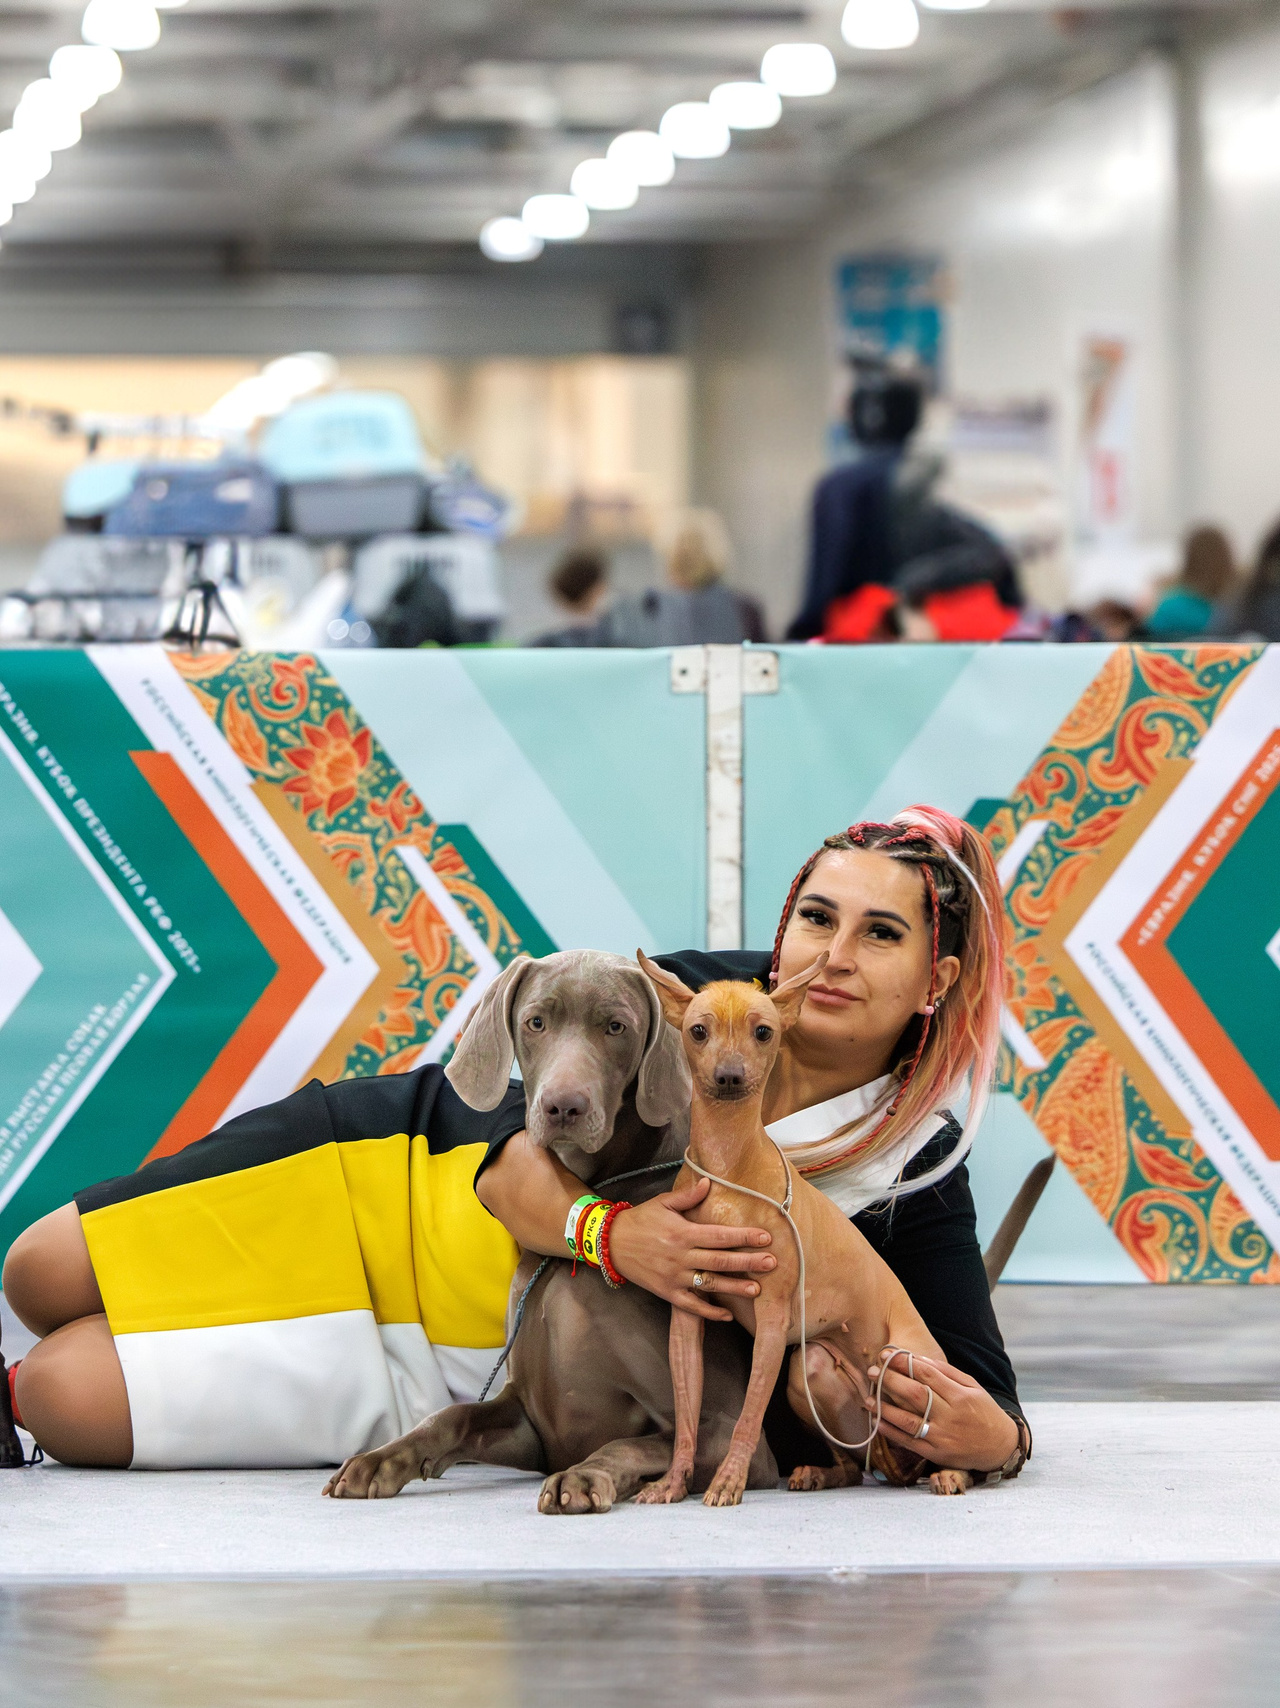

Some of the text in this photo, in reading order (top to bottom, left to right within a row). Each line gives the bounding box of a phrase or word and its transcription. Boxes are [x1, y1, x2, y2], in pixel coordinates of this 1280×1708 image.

[37, 746, 77, 798] КУБОК
[74, 798, 146, 896] ПРЕЗИДЕНТА
[144, 897, 171, 929] РКФ
[7, 1054, 68, 1127] ВЫСТАВКА
[67, 1004, 106, 1051] СОБАК
[11, 1085, 63, 1148] РУССКАЯ
[59, 1027, 108, 1085] ПСОВАЯ
[103, 973, 149, 1028] БОРЗАЯ
